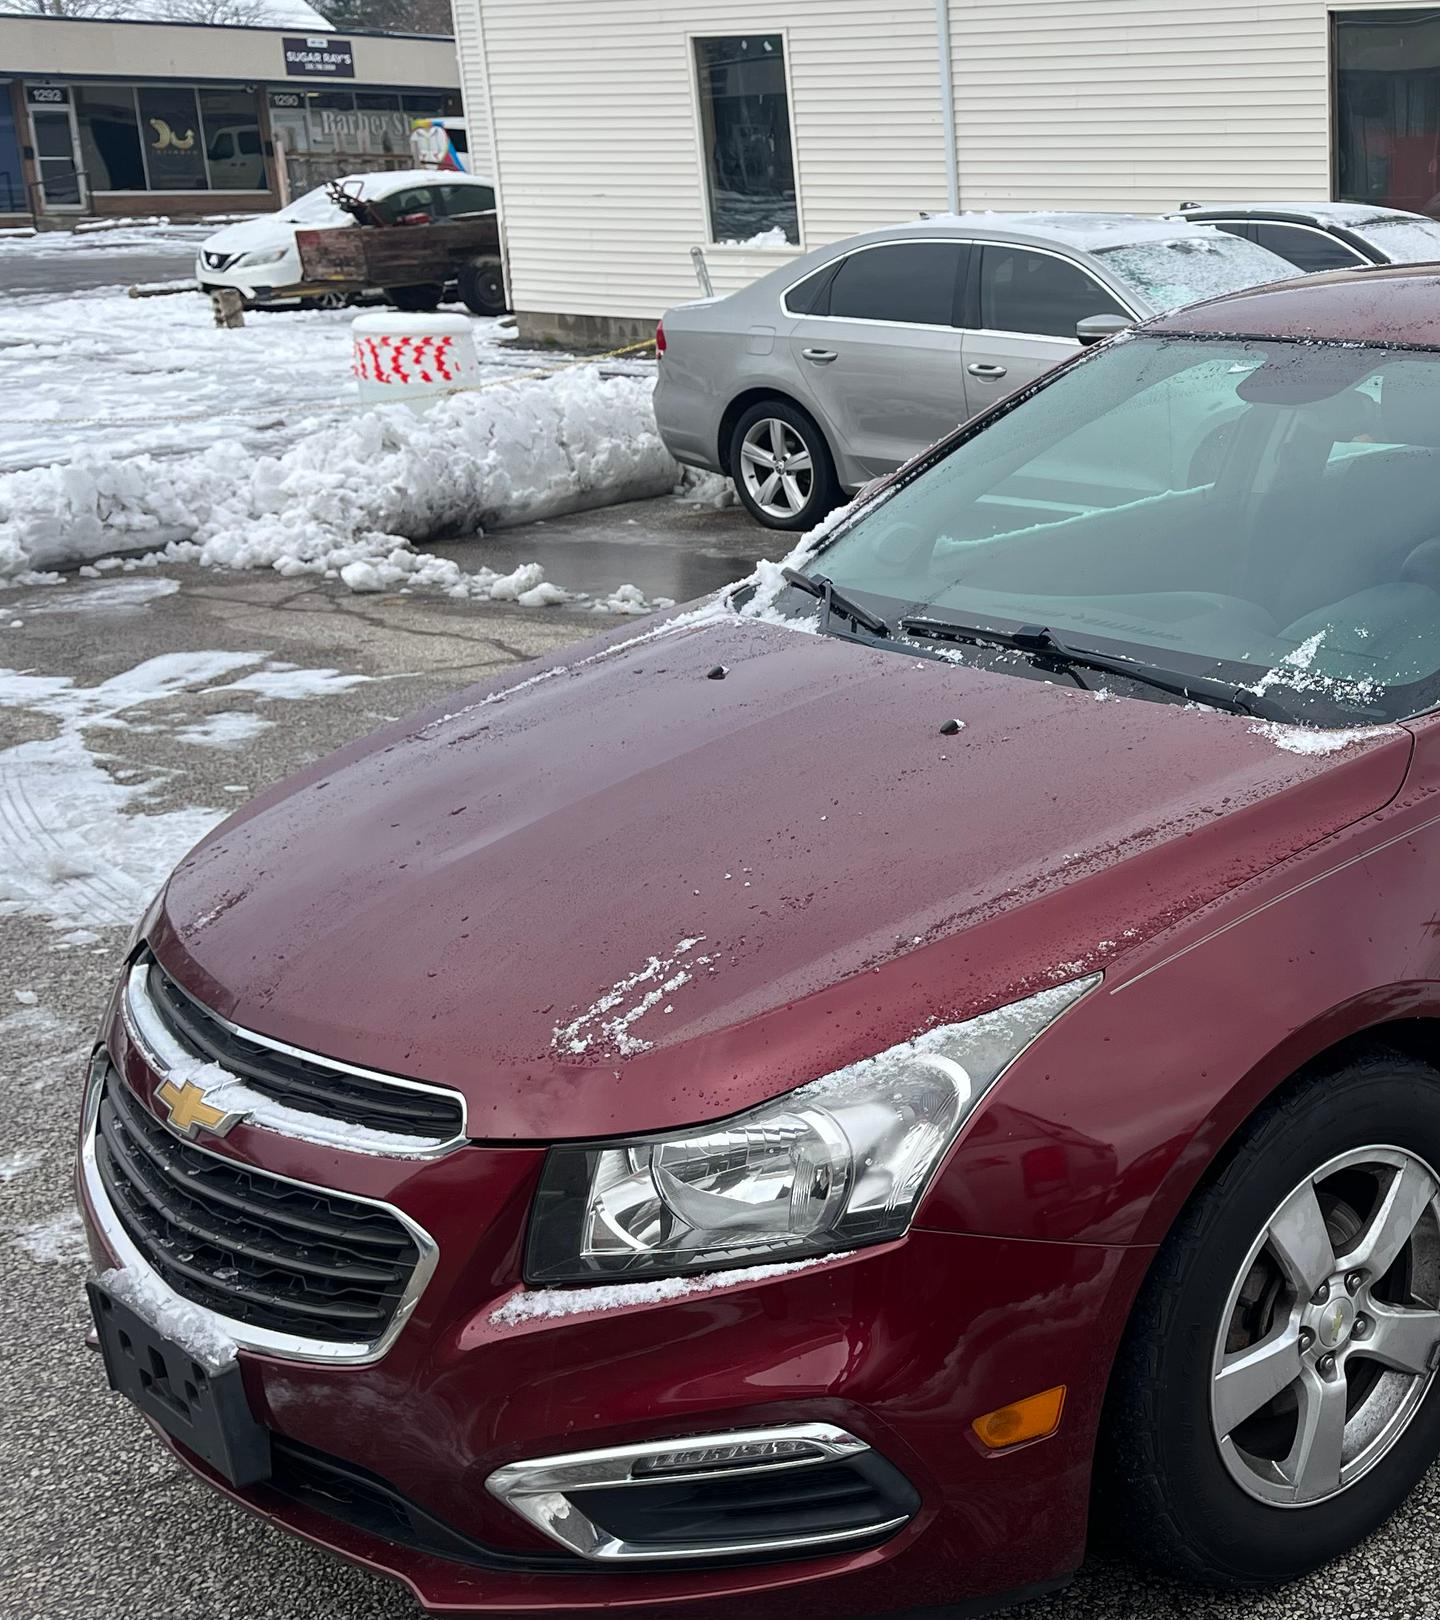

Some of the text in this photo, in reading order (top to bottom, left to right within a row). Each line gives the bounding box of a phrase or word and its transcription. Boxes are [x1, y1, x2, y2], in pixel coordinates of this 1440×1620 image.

[286, 51, 321, 62] SUGAR
[32, 89, 62, 102] 1292
[321, 111, 389, 135] Barber
